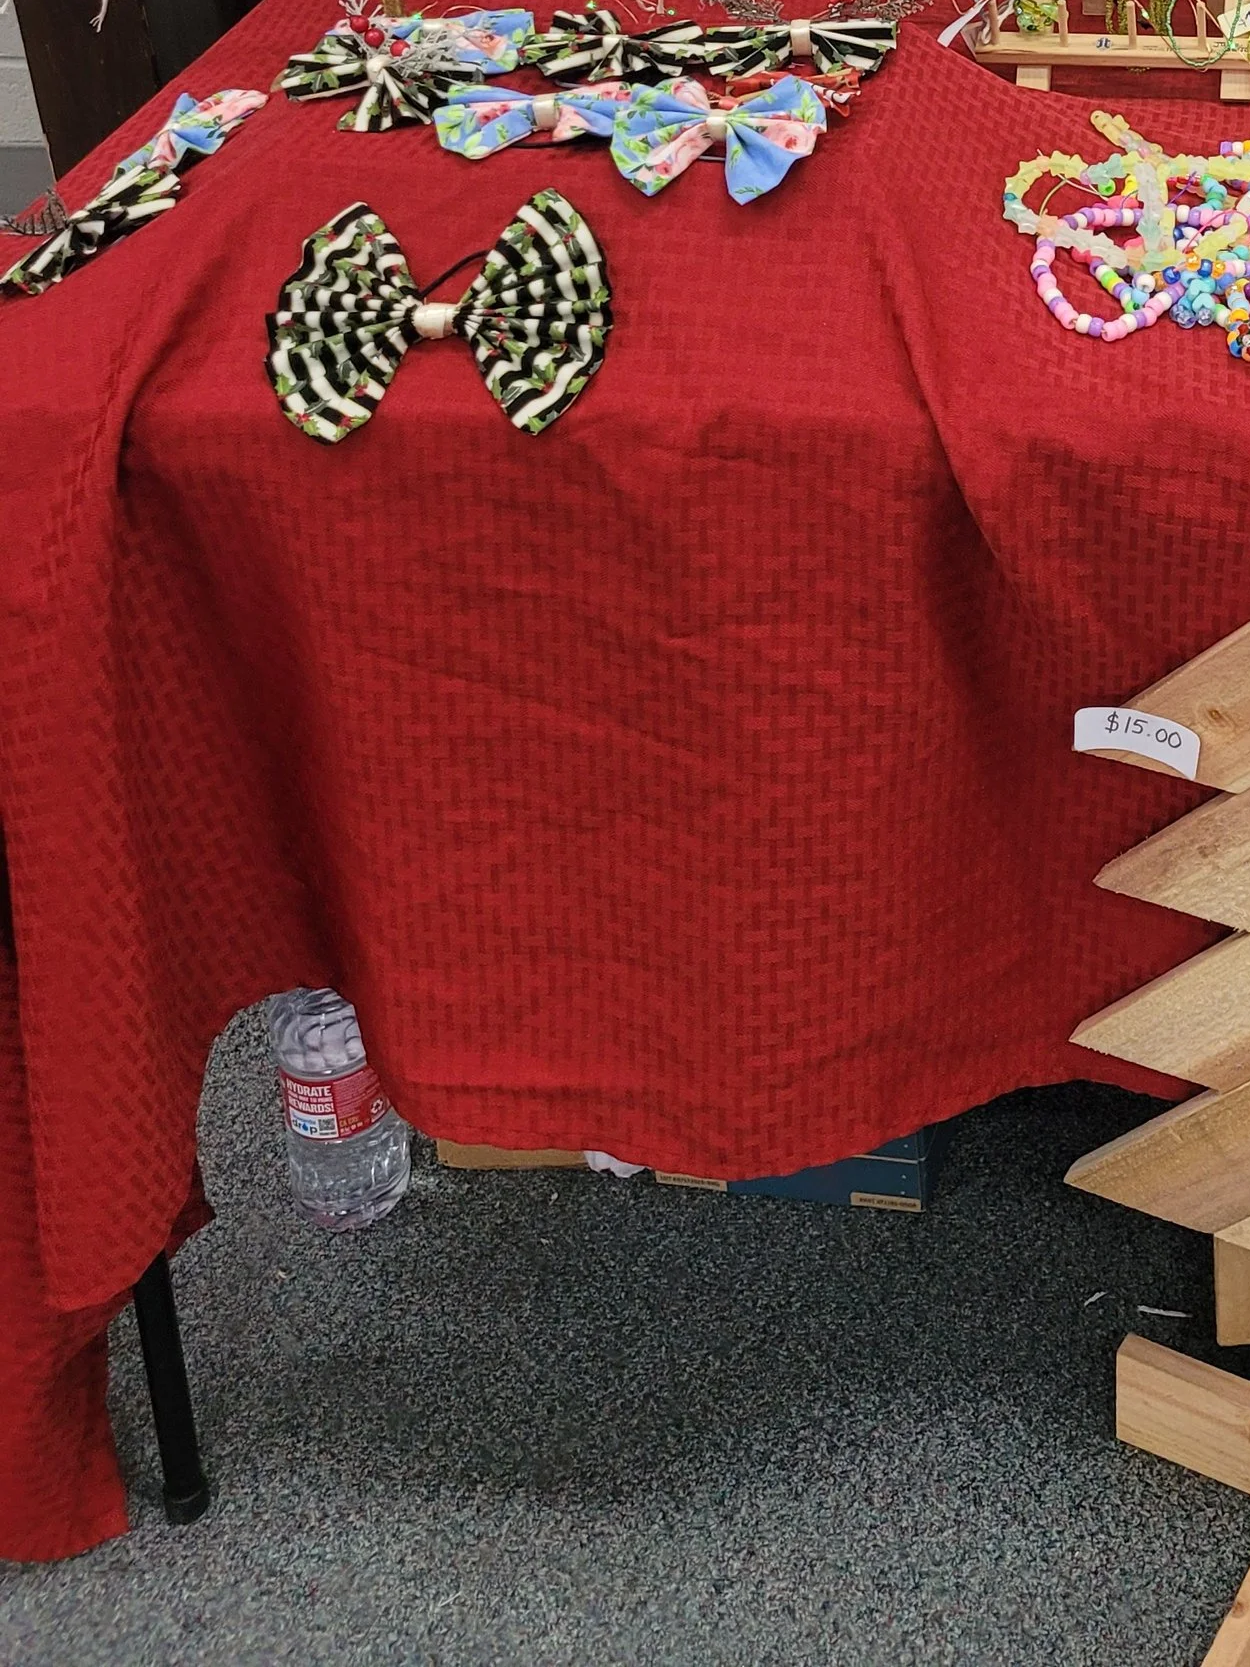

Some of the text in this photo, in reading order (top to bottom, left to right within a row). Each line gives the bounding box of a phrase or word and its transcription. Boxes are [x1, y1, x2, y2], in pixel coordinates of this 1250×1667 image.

[1104, 711, 1182, 749] $15.00
[286, 1078, 332, 1097] HYDRATE
[288, 1095, 335, 1113] REWARDS!
